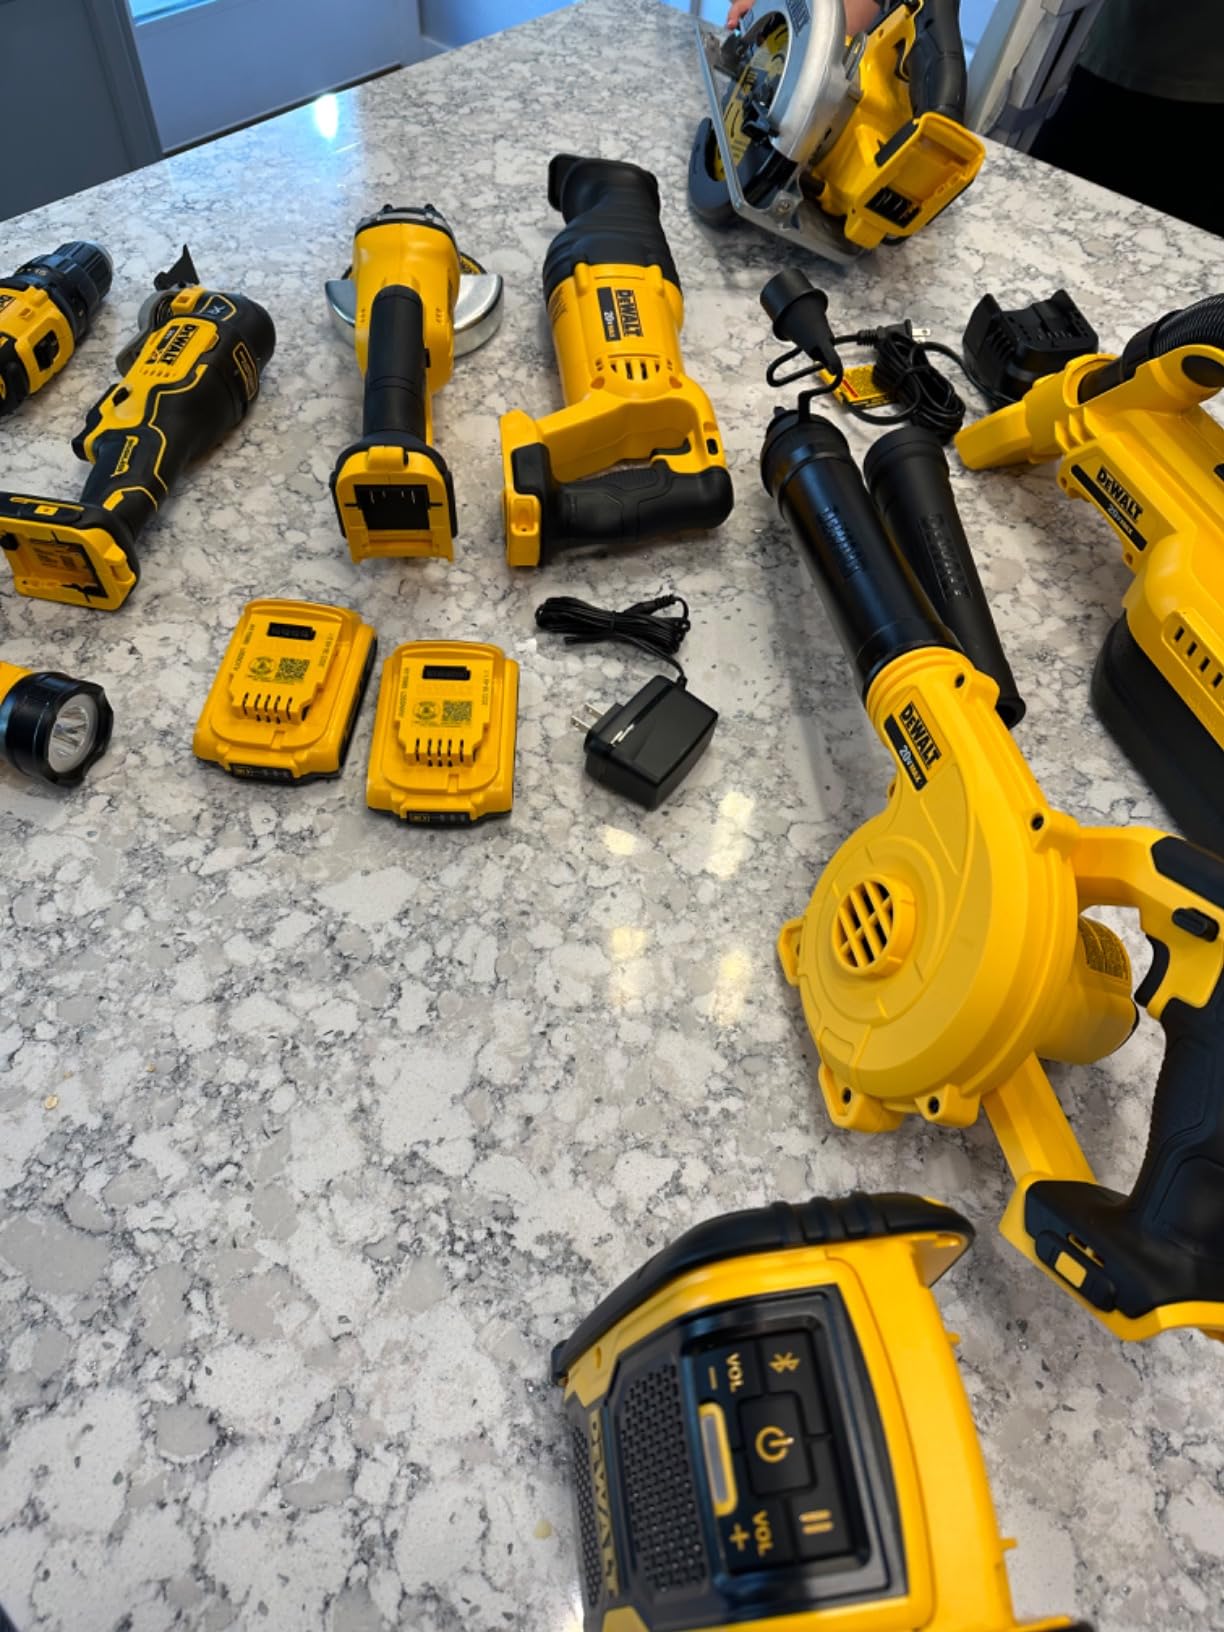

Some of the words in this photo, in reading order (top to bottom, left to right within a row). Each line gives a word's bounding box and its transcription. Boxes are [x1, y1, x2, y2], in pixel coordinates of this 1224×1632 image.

[616, 290, 643, 337] DEWALT
[160, 324, 199, 365] DEWALT
[1097, 466, 1144, 523] DEWALT
[899, 701, 942, 770] DEWALT
[726, 1353, 744, 1392] VOL
[752, 1511, 774, 1556] VOL
